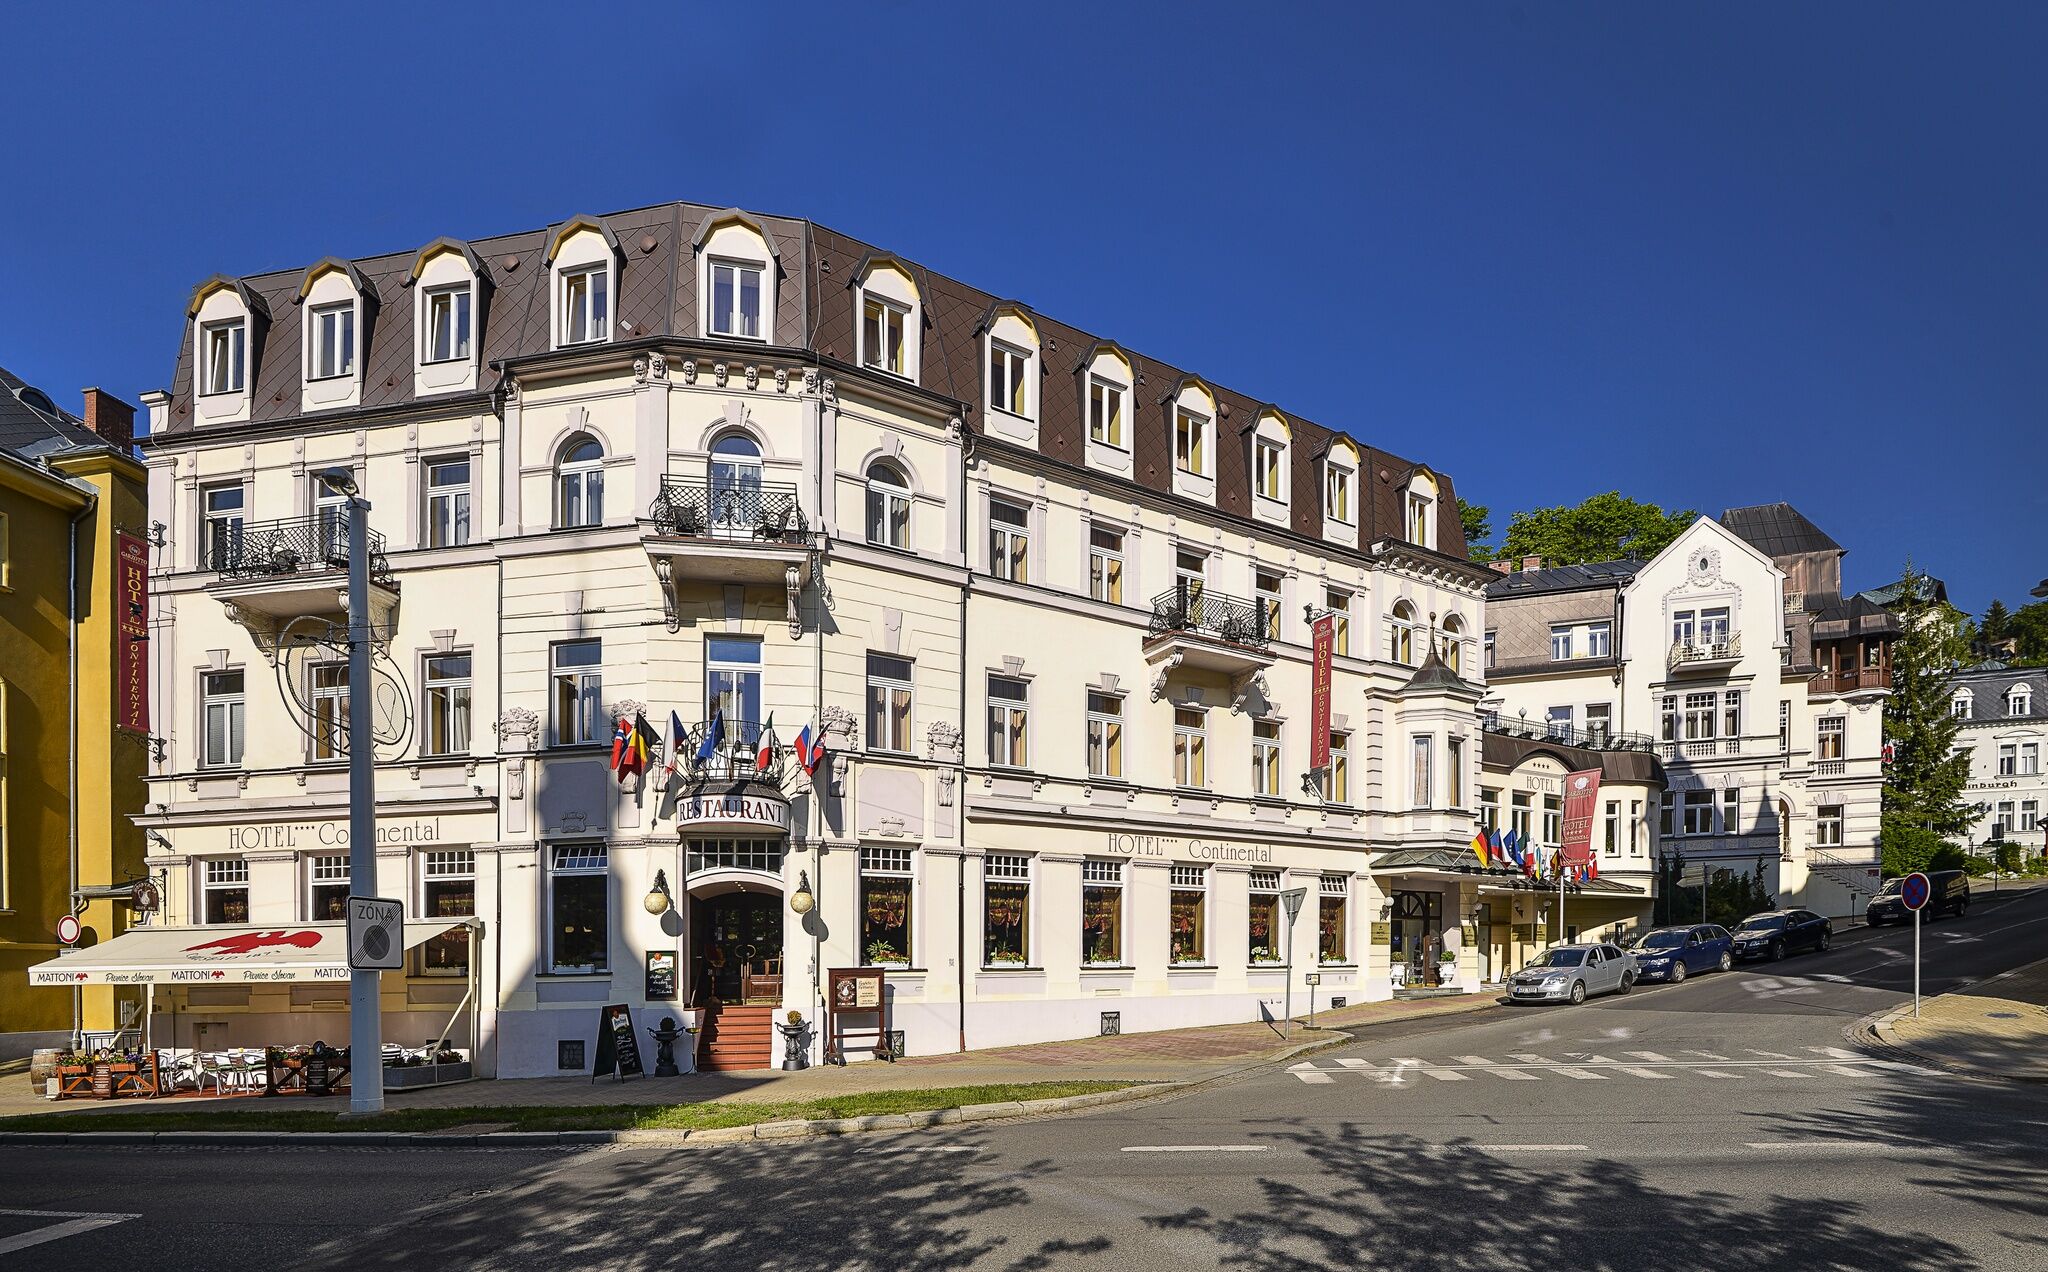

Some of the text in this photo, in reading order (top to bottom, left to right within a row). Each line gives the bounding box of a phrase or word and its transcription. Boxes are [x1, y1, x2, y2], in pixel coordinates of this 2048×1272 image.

[128, 566, 142, 625] HOTL
[1319, 641, 1327, 685] HOTEL
[130, 637, 140, 726] ONTINENTAL
[1526, 775, 1554, 792] HOTEL
[680, 799, 783, 823] RESTAURANT
[229, 817, 440, 849] HOTEL Conental
[1108, 834, 1272, 863] HOTEL Continental
[358, 903, 393, 920] ZÓNA
[37, 972, 75, 983] MATTONI
[171, 970, 210, 981] MATTONI
